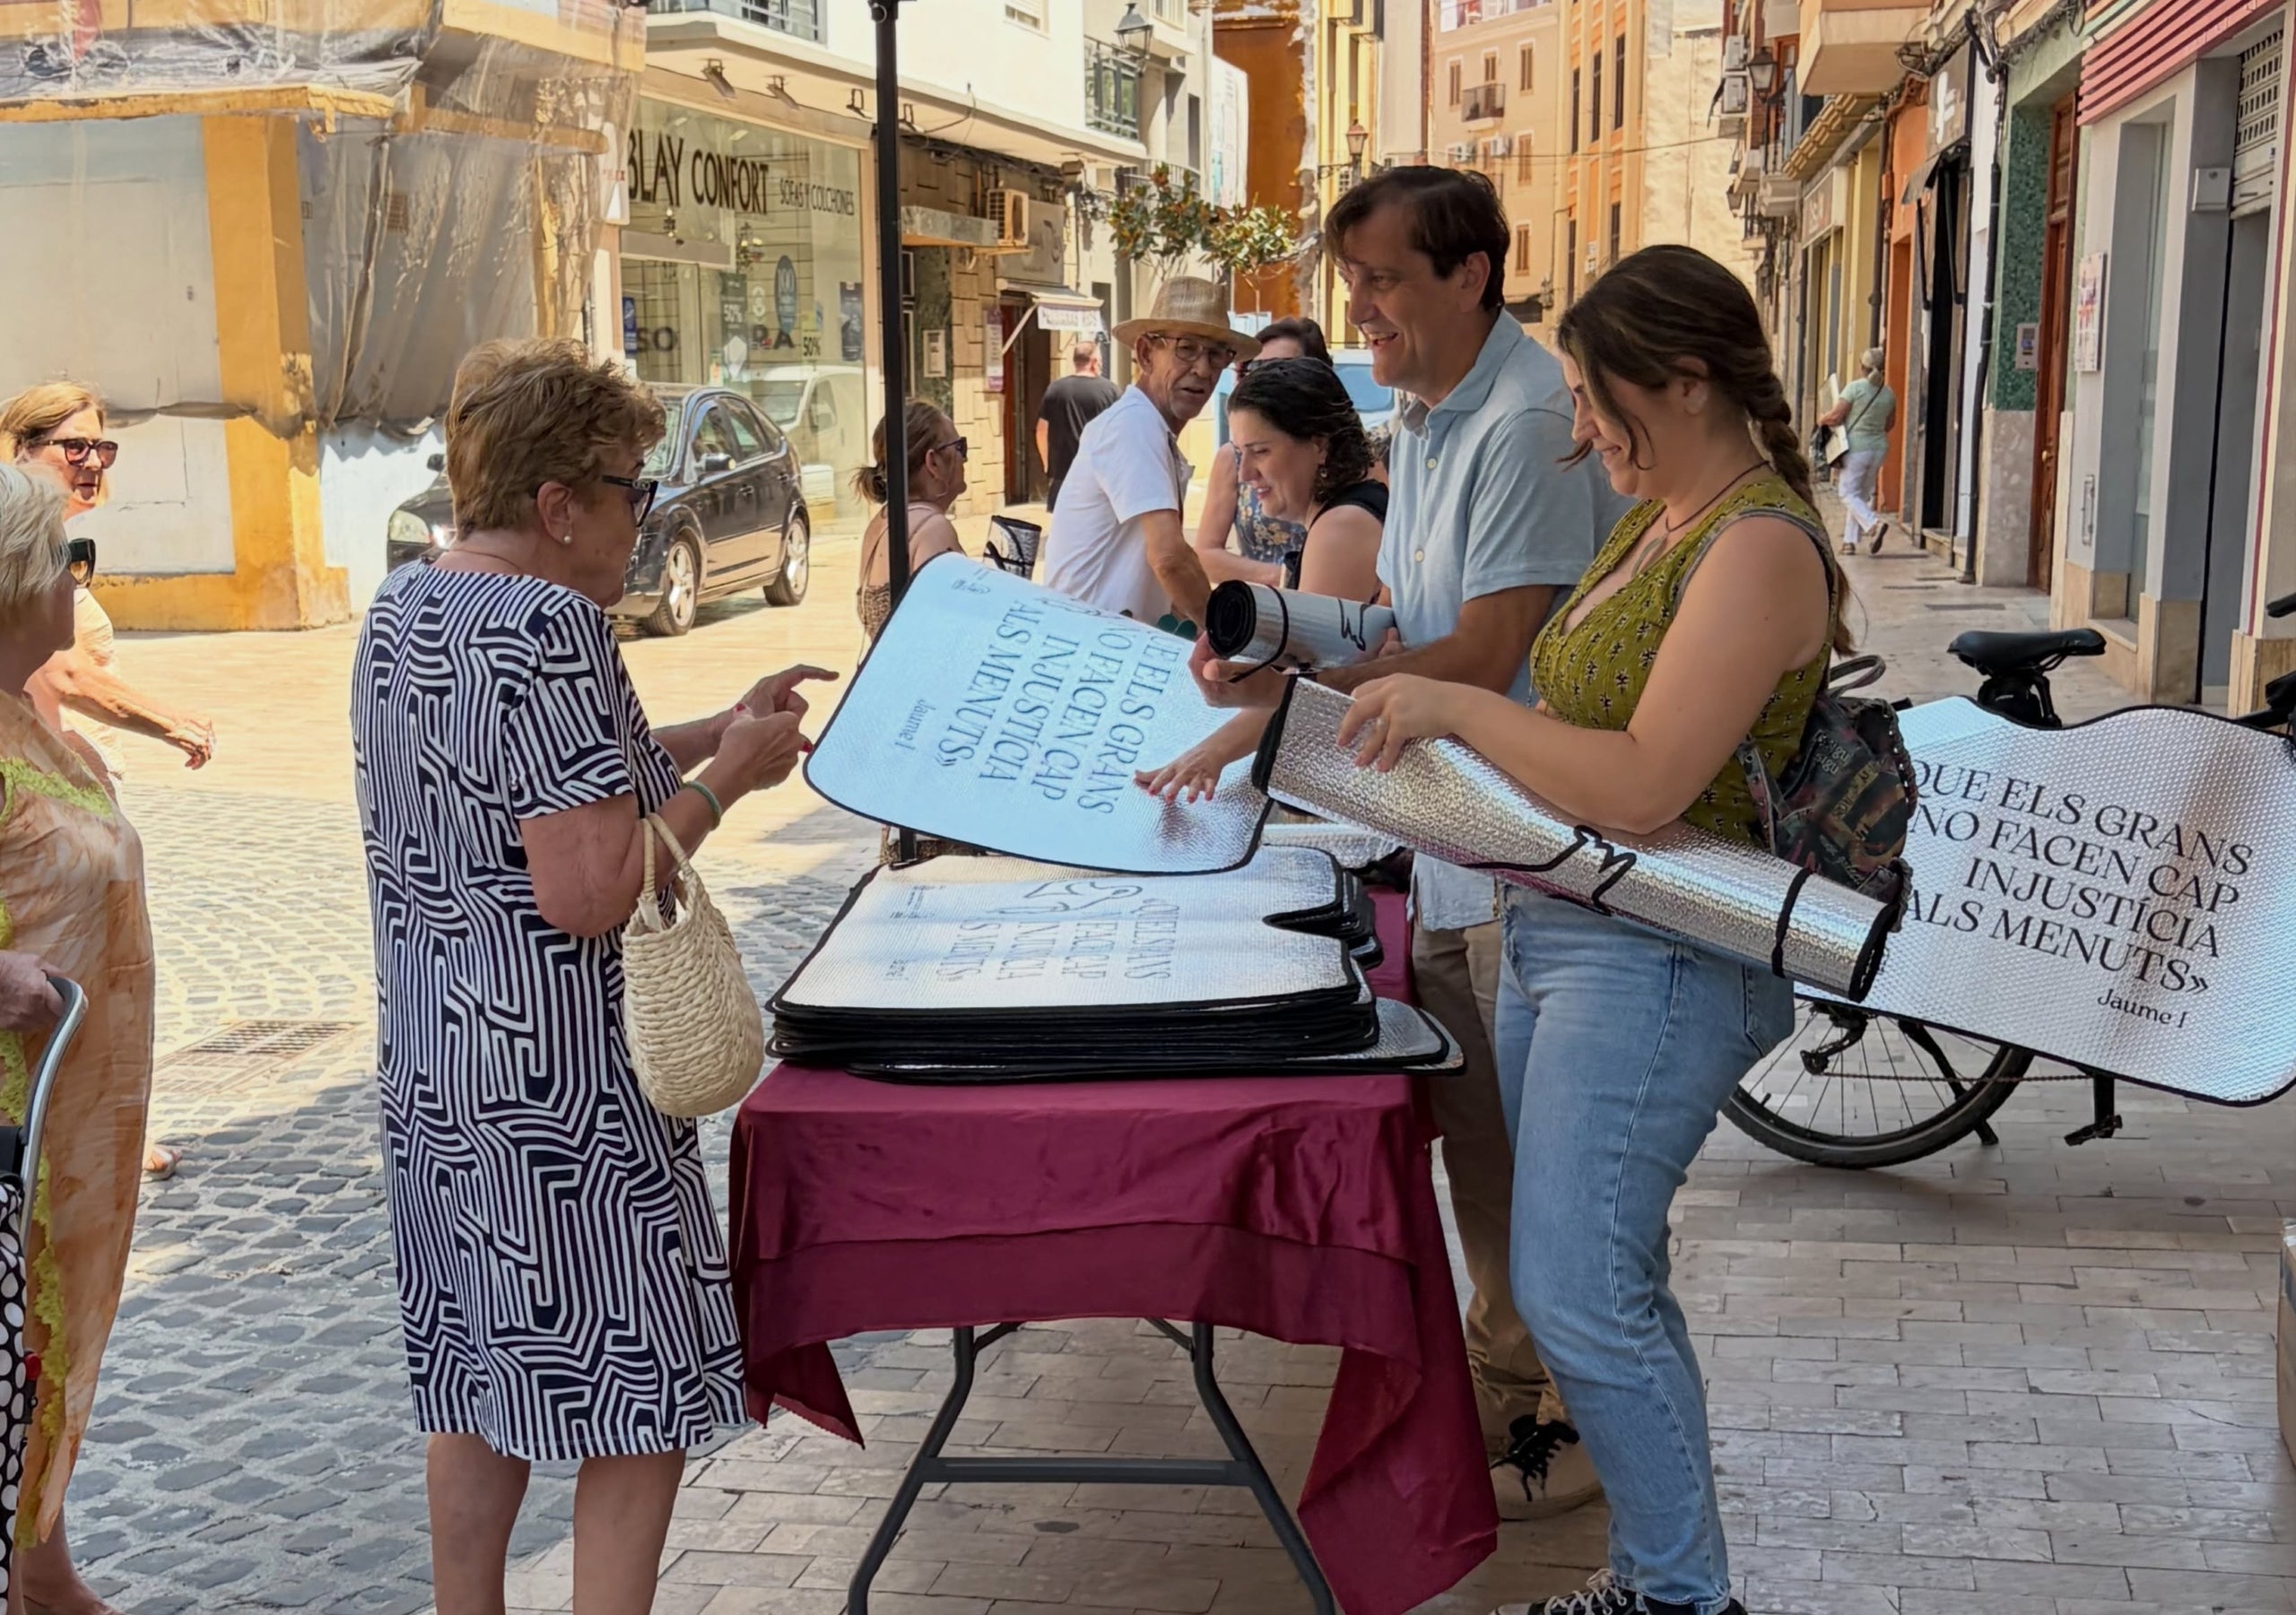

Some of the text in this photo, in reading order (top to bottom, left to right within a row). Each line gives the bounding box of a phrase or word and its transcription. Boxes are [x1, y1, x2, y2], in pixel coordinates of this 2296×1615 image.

[628, 129, 770, 215] BLAY CONFORT
[812, 185, 855, 216] COLCHONES
[995, 600, 1044, 644] ALS
[898, 697, 938, 740] Jaume
[936, 643, 1022, 768] MENUTS»
[1060, 651, 1124, 748] FACEN
[1119, 665, 1172, 721] ELS
[1031, 748, 1082, 802] CAP
[1076, 723, 1145, 815] GRANS
[1909, 804, 2239, 914] NO FACEN CAP
[1998, 777, 2086, 825] ELS
[2094, 804, 2254, 875] GRANS
[1905, 889, 2210, 994] ALS MENUTS»
[1963, 857, 2220, 959] INJUSTÍCIA
[2097, 988, 2172, 1026] Jaume
